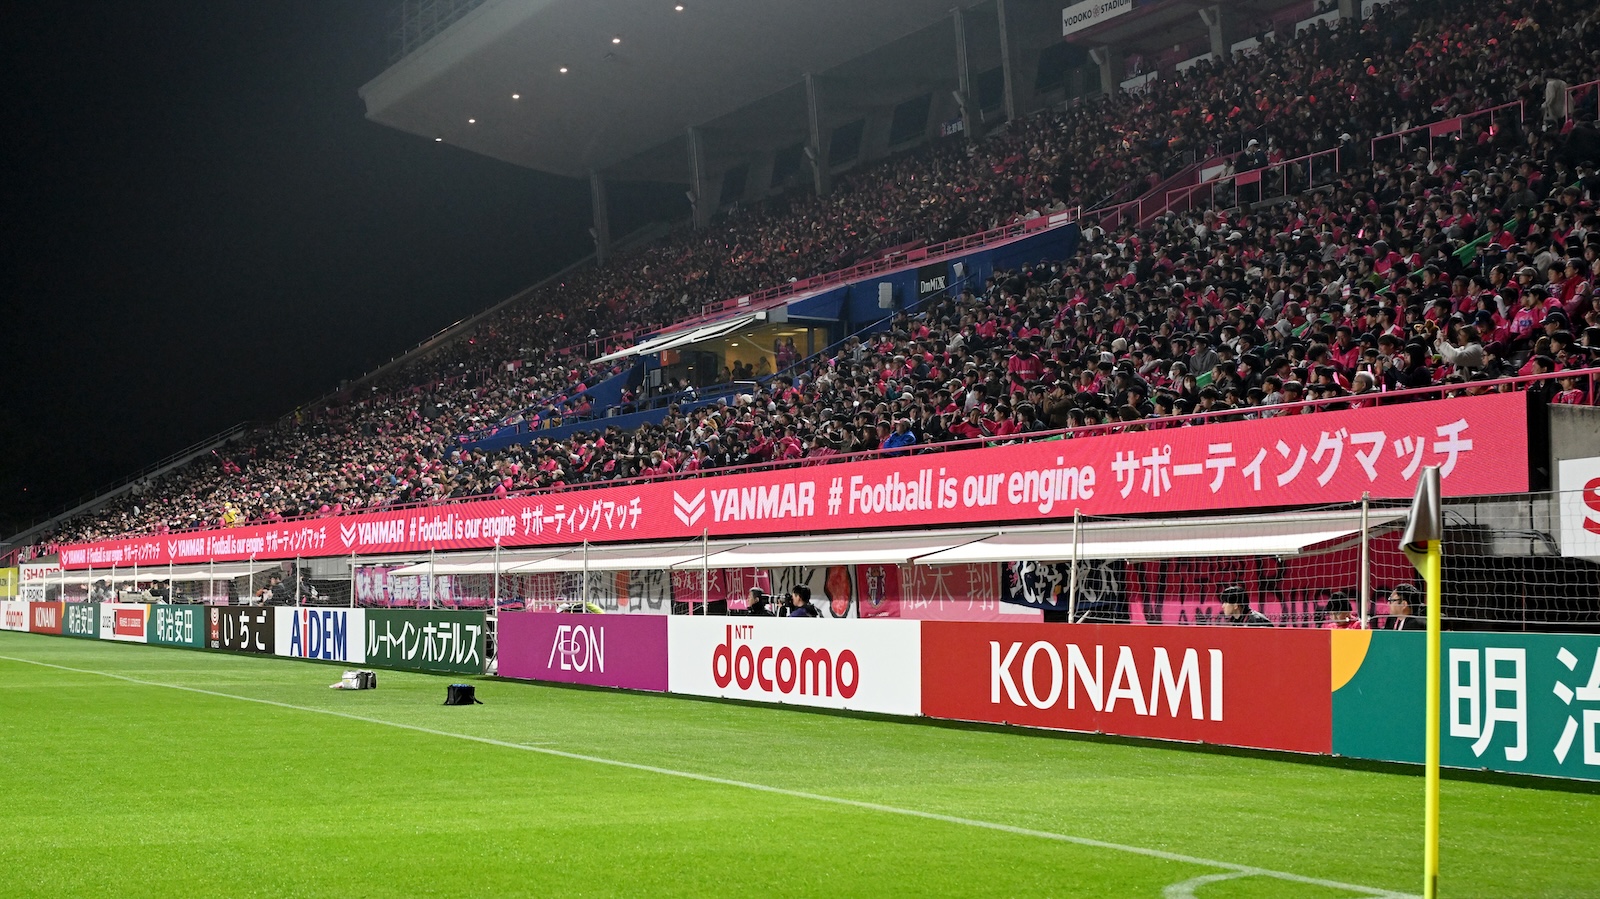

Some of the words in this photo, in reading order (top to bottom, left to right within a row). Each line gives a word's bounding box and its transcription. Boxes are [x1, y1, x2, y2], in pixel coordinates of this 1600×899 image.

[1064, 10, 1092, 26] YODOKO
[711, 481, 816, 522] YANMAR
[828, 477, 843, 516] #
[848, 468, 933, 514] Football
[938, 467, 958, 508] is
[963, 472, 1005, 507] our
[1008, 456, 1096, 514] engine
[1111, 417, 1474, 498] サポーティングマッチ
[178, 538, 204, 556] YANMAR
[211, 534, 231, 555] Football
[246, 532, 264, 558] engine
[266, 526, 326, 552] サポーティングマッチ
[358, 519, 404, 545] YANMAR
[418, 514, 453, 542] Football
[455, 513, 463, 539] is
[464, 517, 482, 539] our
[482, 509, 516, 544] engine
[521, 496, 643, 536] サポーティングマッチ
[156, 608, 192, 643] 明治安田
[223, 610, 266, 651] いちご
[290, 608, 348, 661] AiDEM
[366, 619, 481, 666] ルートインホテルズ
[735, 625, 754, 640] NTT
[713, 624, 860, 699] docomo
[989, 640, 1224, 722] KONAMI
